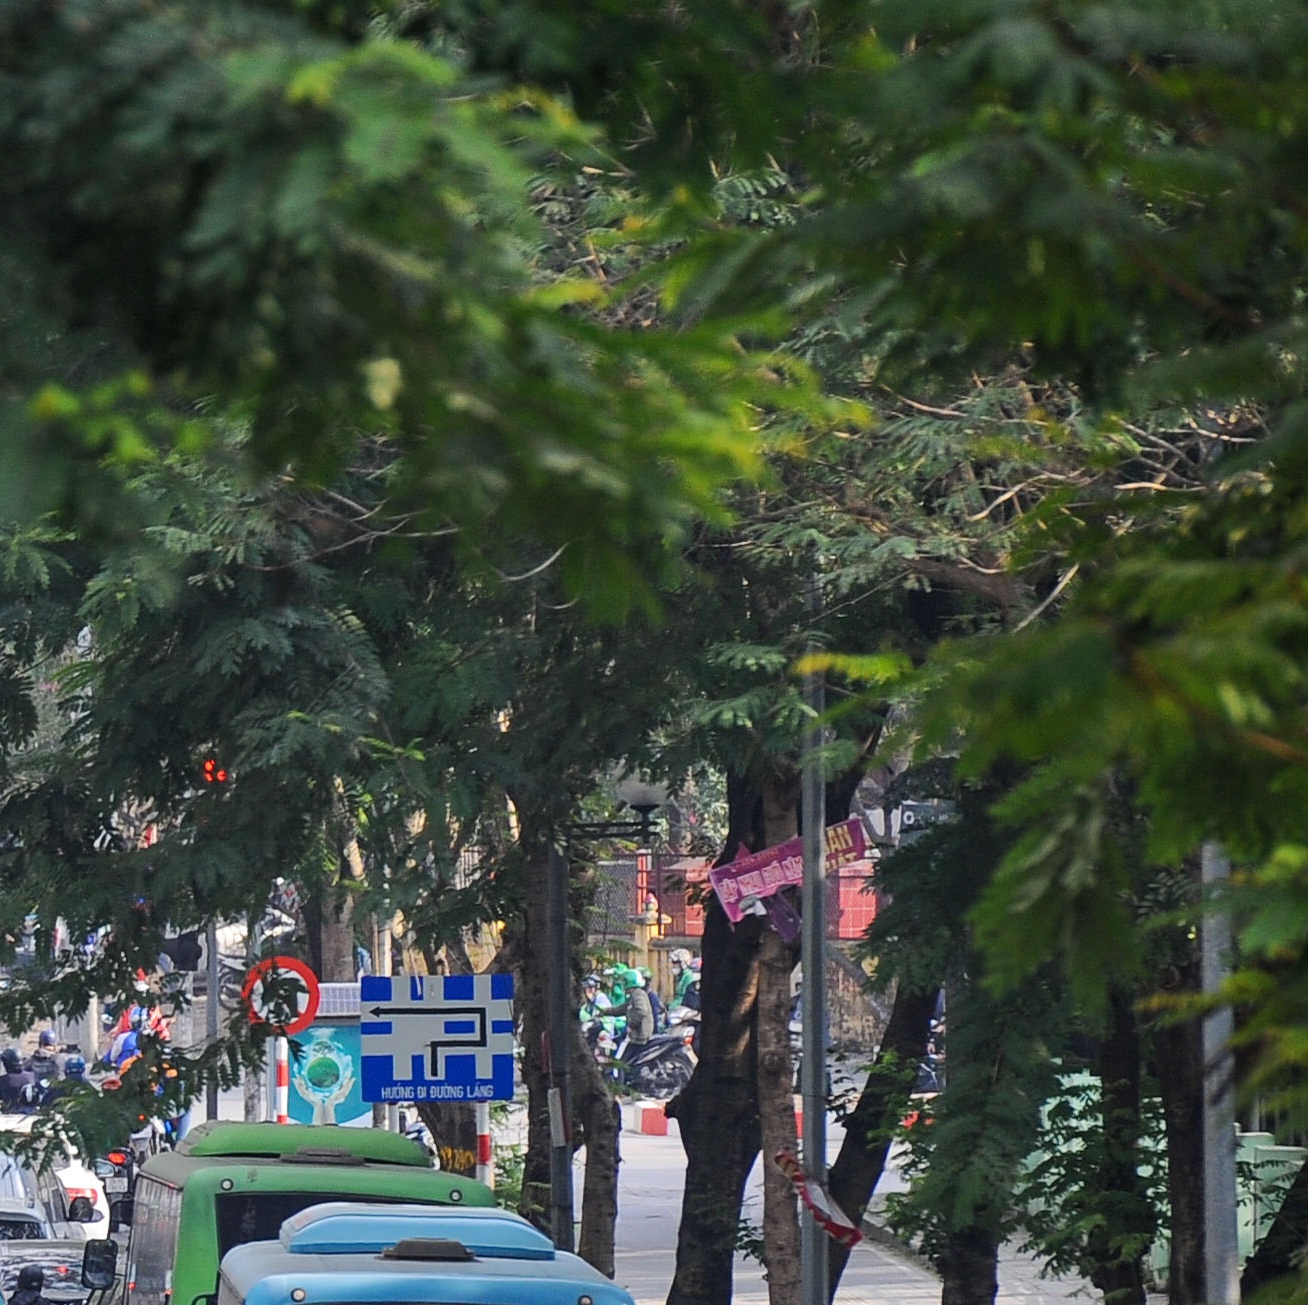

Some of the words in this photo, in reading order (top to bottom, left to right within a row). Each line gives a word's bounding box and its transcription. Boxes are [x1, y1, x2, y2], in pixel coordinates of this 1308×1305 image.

[381, 1083, 414, 1099] HƯỚNG
[417, 1085, 427, 1098] ĐI
[430, 1083, 464, 1099] ĐƯỜNG
[467, 1082, 494, 1098] LÁNG
